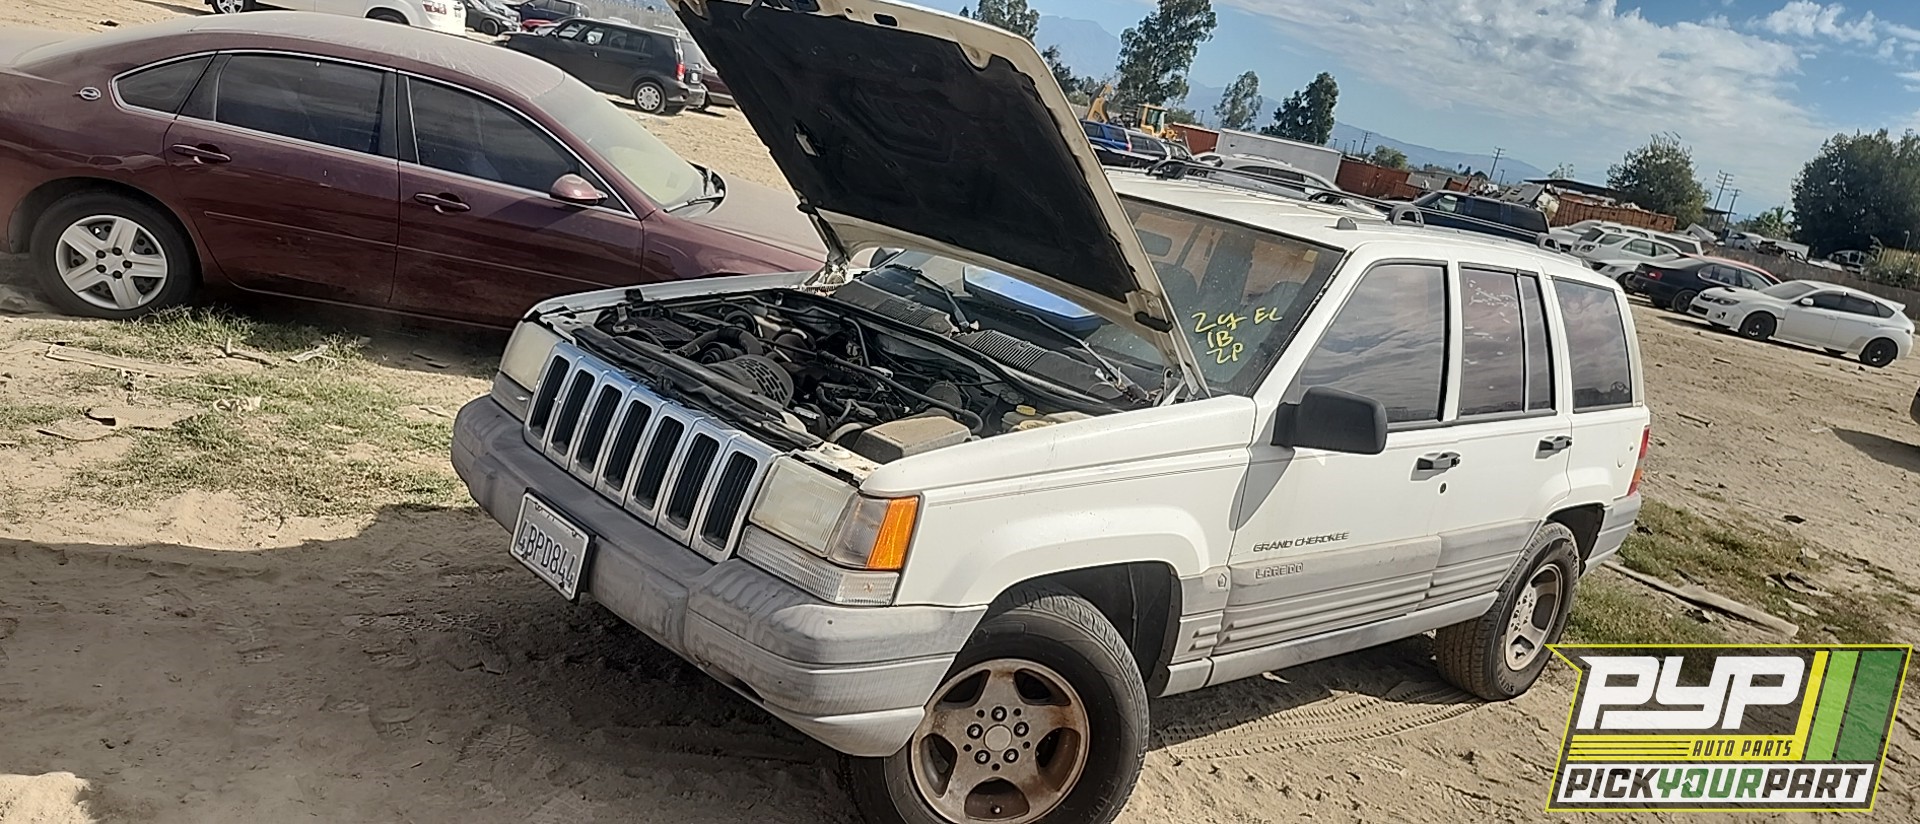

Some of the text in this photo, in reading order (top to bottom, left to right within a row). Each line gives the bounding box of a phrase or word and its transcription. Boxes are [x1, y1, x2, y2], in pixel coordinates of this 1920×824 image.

[1253, 532, 1349, 552] GRAND CHEROKEE
[517, 520, 576, 588] 4BPD844
[1255, 562, 1304, 579] LAREDO
